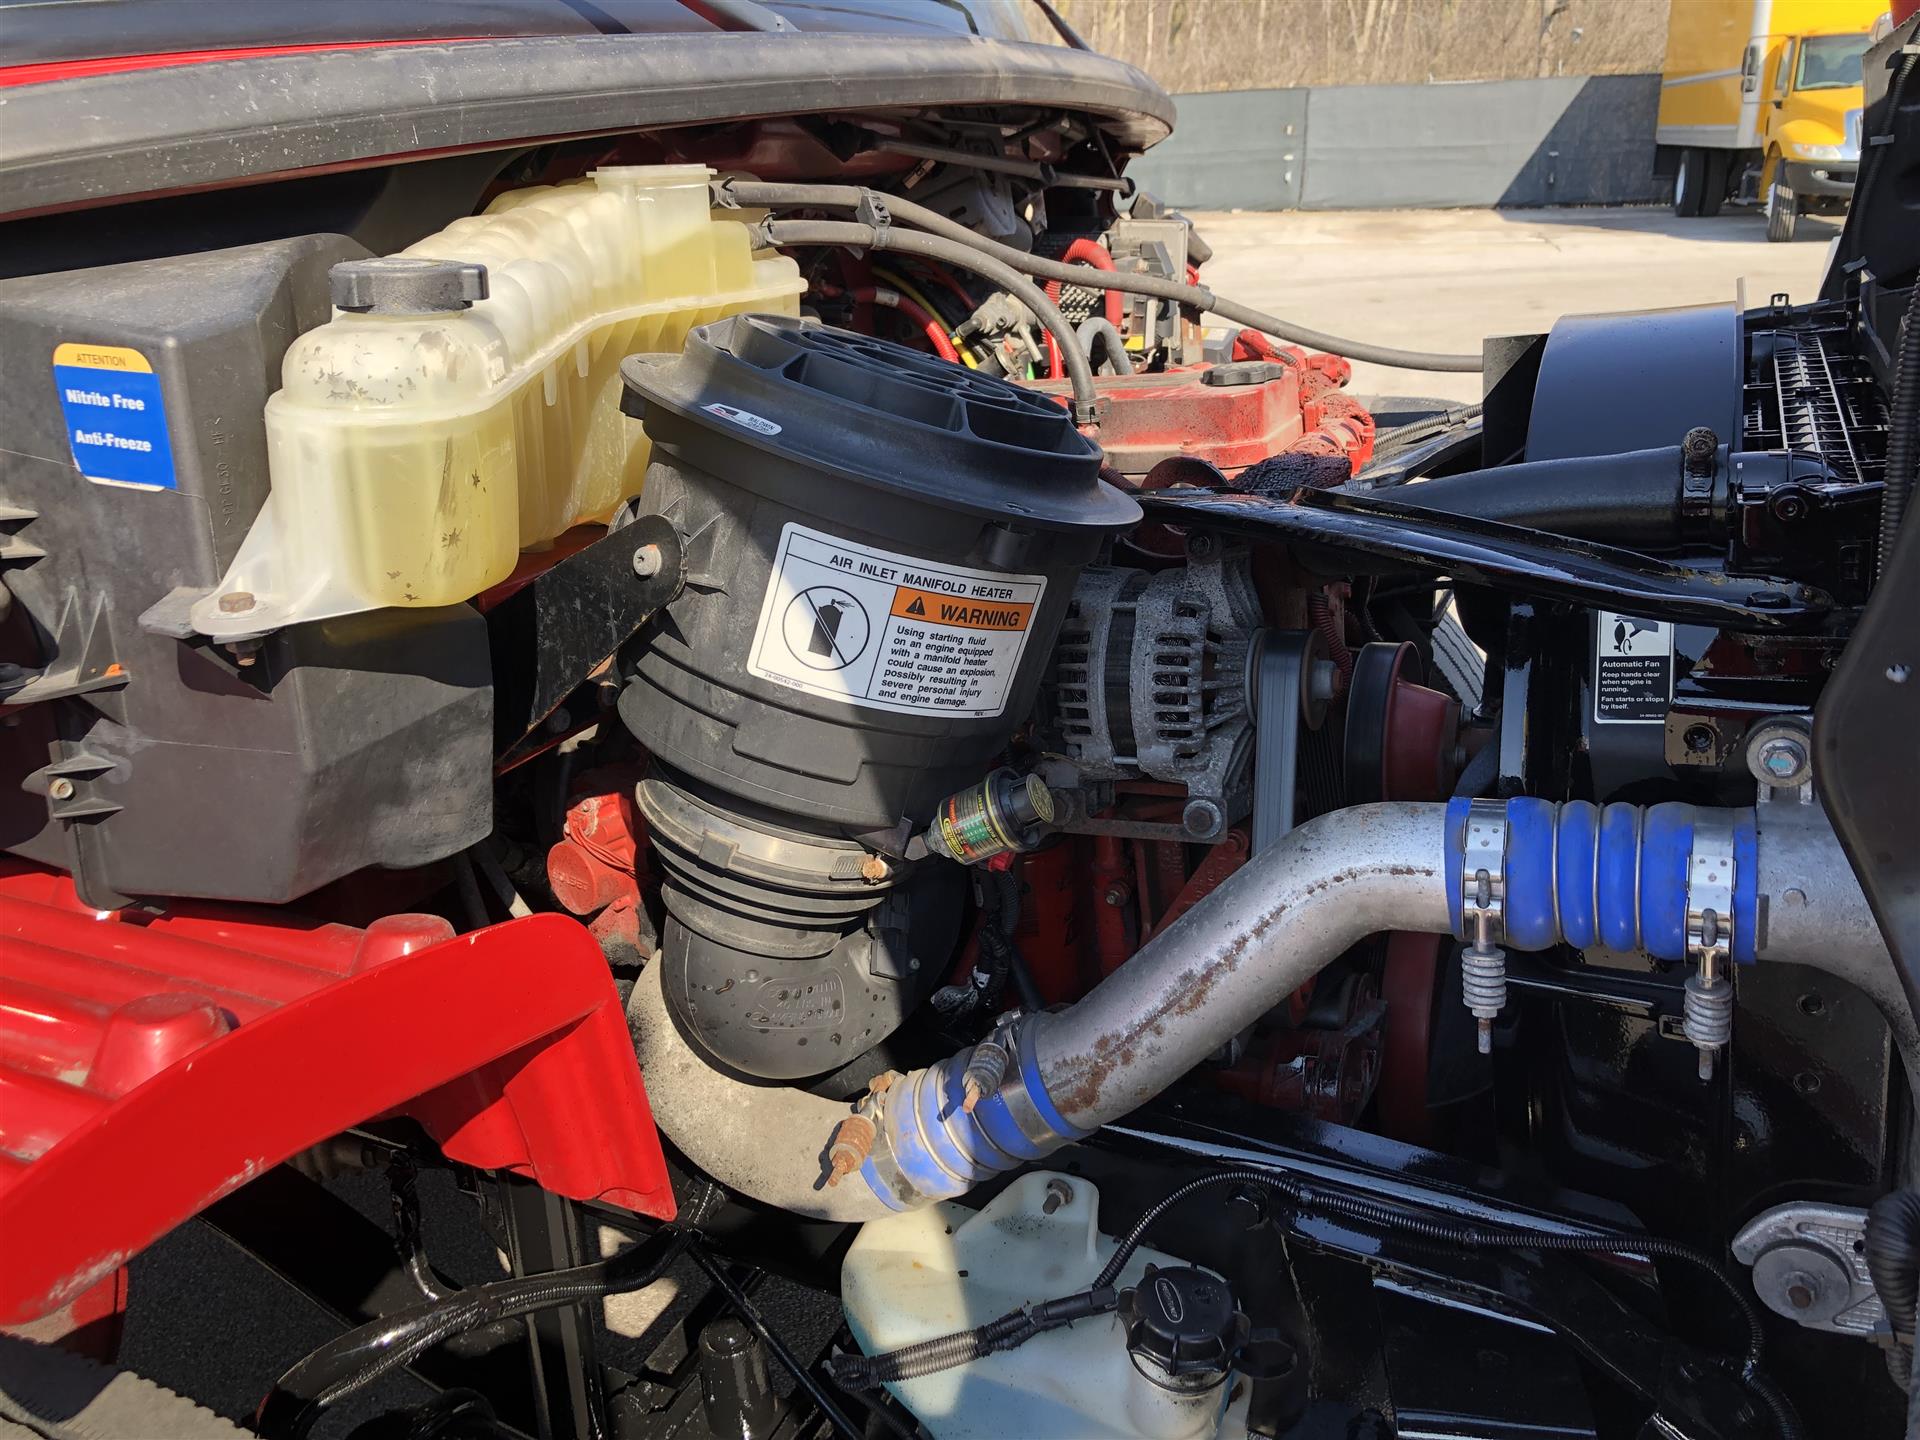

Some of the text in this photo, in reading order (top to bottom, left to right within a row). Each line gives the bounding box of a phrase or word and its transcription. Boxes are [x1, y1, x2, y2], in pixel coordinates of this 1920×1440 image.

[76, 353, 126, 368] ATTENTION
[65, 389, 145, 411] Nitrite Free
[75, 430, 152, 452] Anti-Freeze
[829, 554, 1013, 599] AIR INLET MANIFOLD HEATER
[941, 604, 1020, 627] WARNING
[897, 625, 987, 646] Using starting fluid
[891, 647, 910, 658] with
[923, 653, 961, 665] manifold
[964, 657, 988, 666] heater
[893, 637, 994, 658] on an engine equipped
[884, 668, 978, 687] possibly resulting in
[887, 658, 996, 677] could cause an explosion,
[878, 689, 967, 707] and engine damage.
[881, 679, 982, 698] severe personal injury
